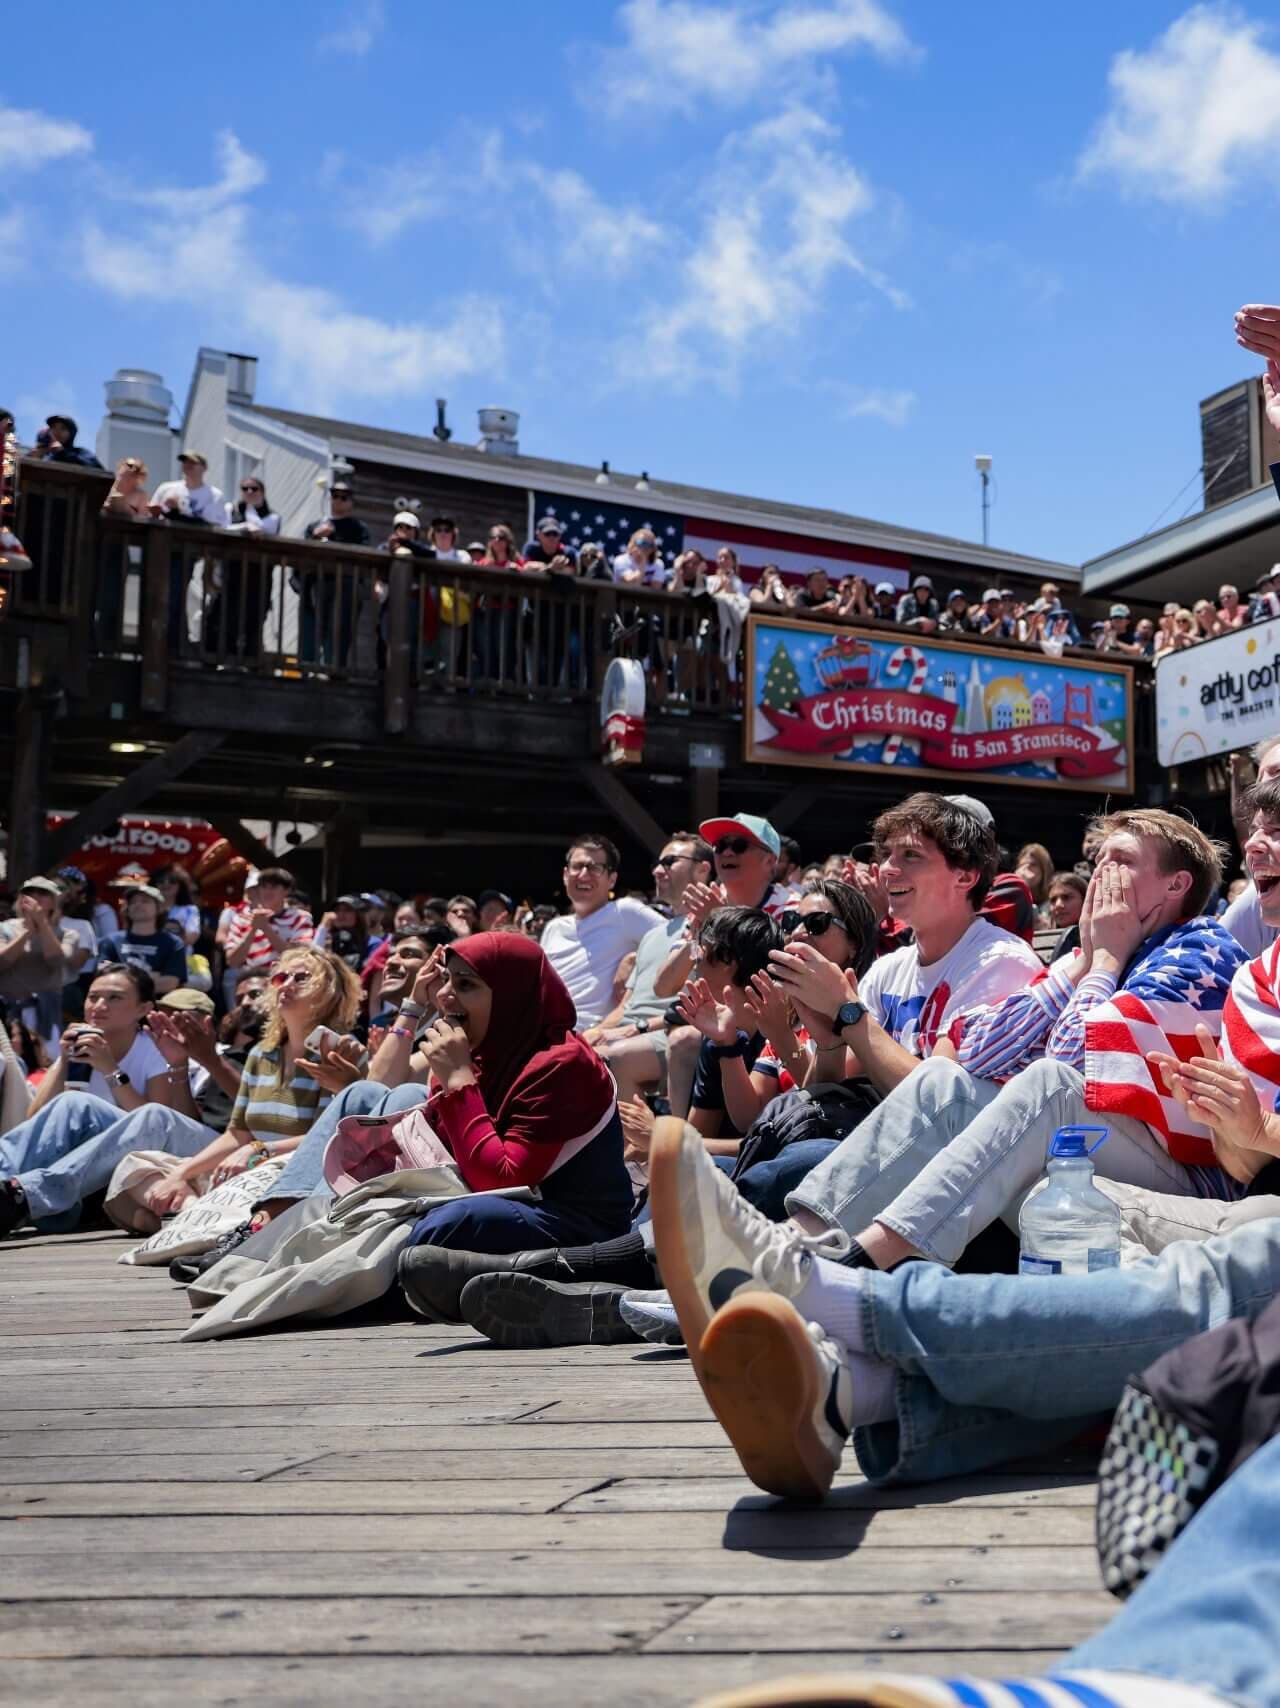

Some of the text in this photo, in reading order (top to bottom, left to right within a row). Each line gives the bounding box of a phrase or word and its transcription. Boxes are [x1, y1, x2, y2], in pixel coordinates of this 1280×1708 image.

[1201, 671, 1244, 706] artly
[811, 696, 948, 732] Christmas
[951, 728, 1091, 759] in San Francisco
[82, 829, 192, 854] UN FOOD
